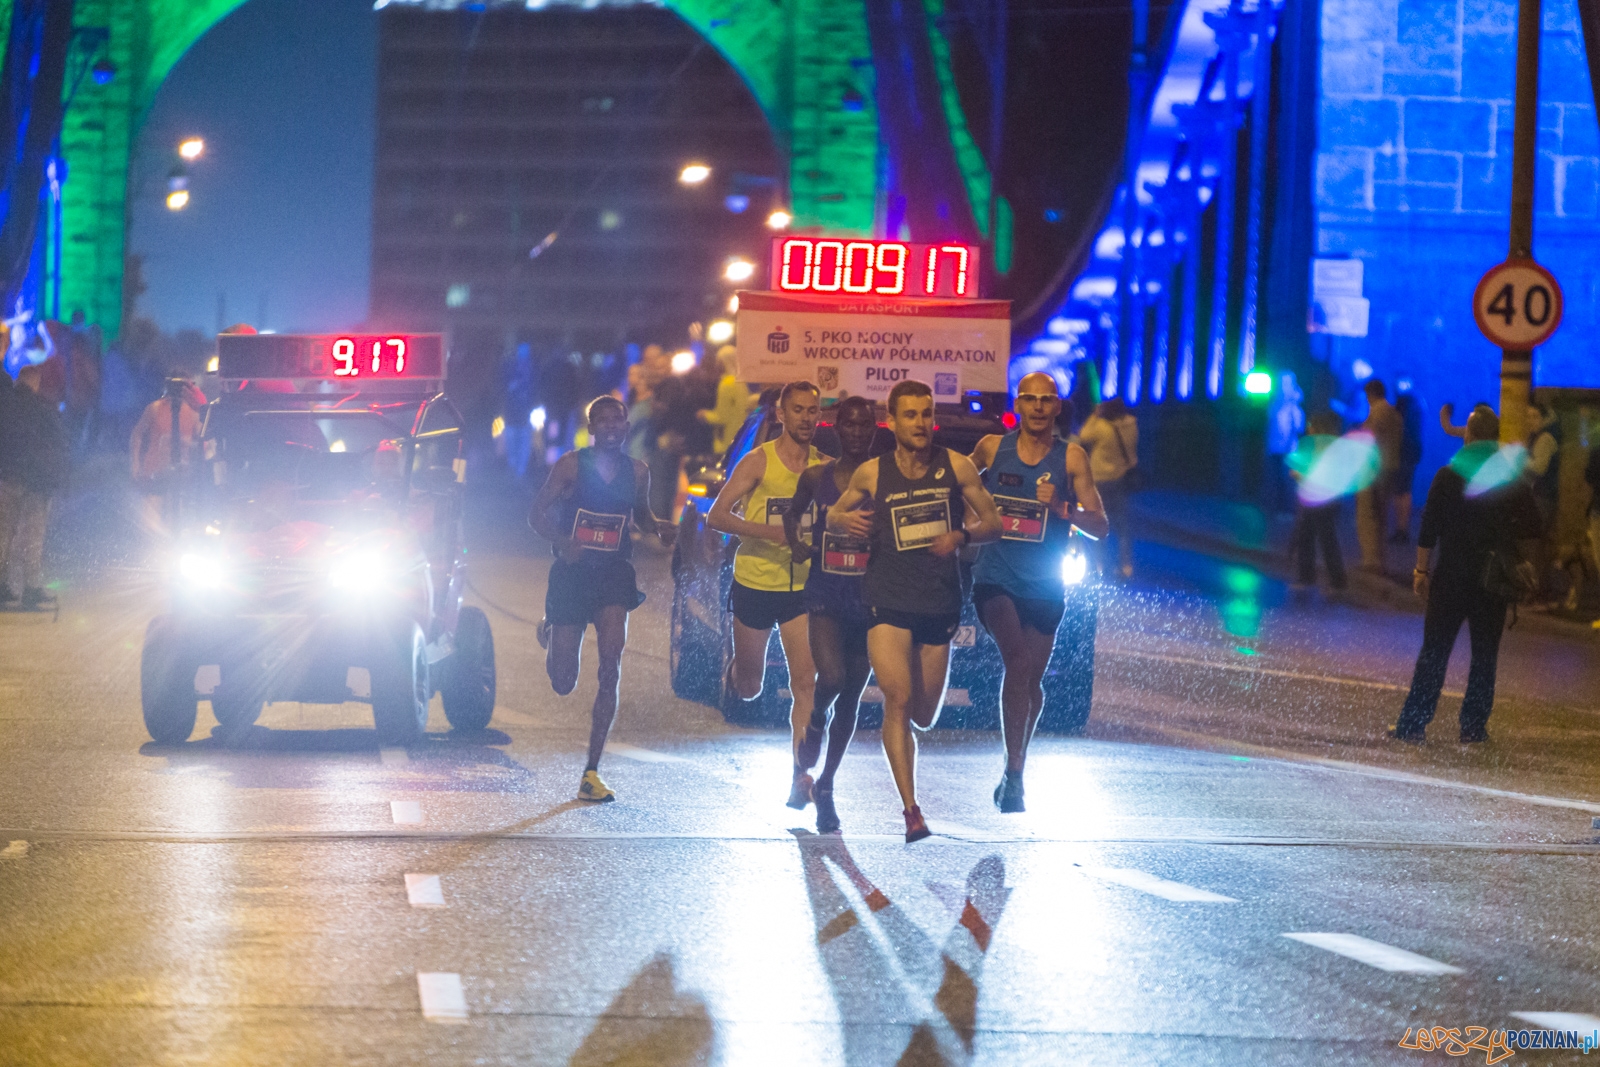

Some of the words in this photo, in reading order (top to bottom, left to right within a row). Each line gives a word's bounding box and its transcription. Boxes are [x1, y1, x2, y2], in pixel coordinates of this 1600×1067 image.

[838, 302, 920, 314] DATASPORT
[1487, 283, 1550, 326] 40
[804, 331, 816, 343] 5.
[822, 331, 852, 343] PKO
[857, 332, 914, 345] NOCNY
[804, 347, 885, 361] WROCŁAW
[890, 346, 996, 363] PÓŁMARATON
[865, 366, 910, 382] PILOT
[866, 384, 892, 392] MARAT
[1011, 518, 1020, 531] 2
[593, 531, 604, 542] 15
[918, 525, 931, 537] 21
[843, 554, 856, 566] 19
